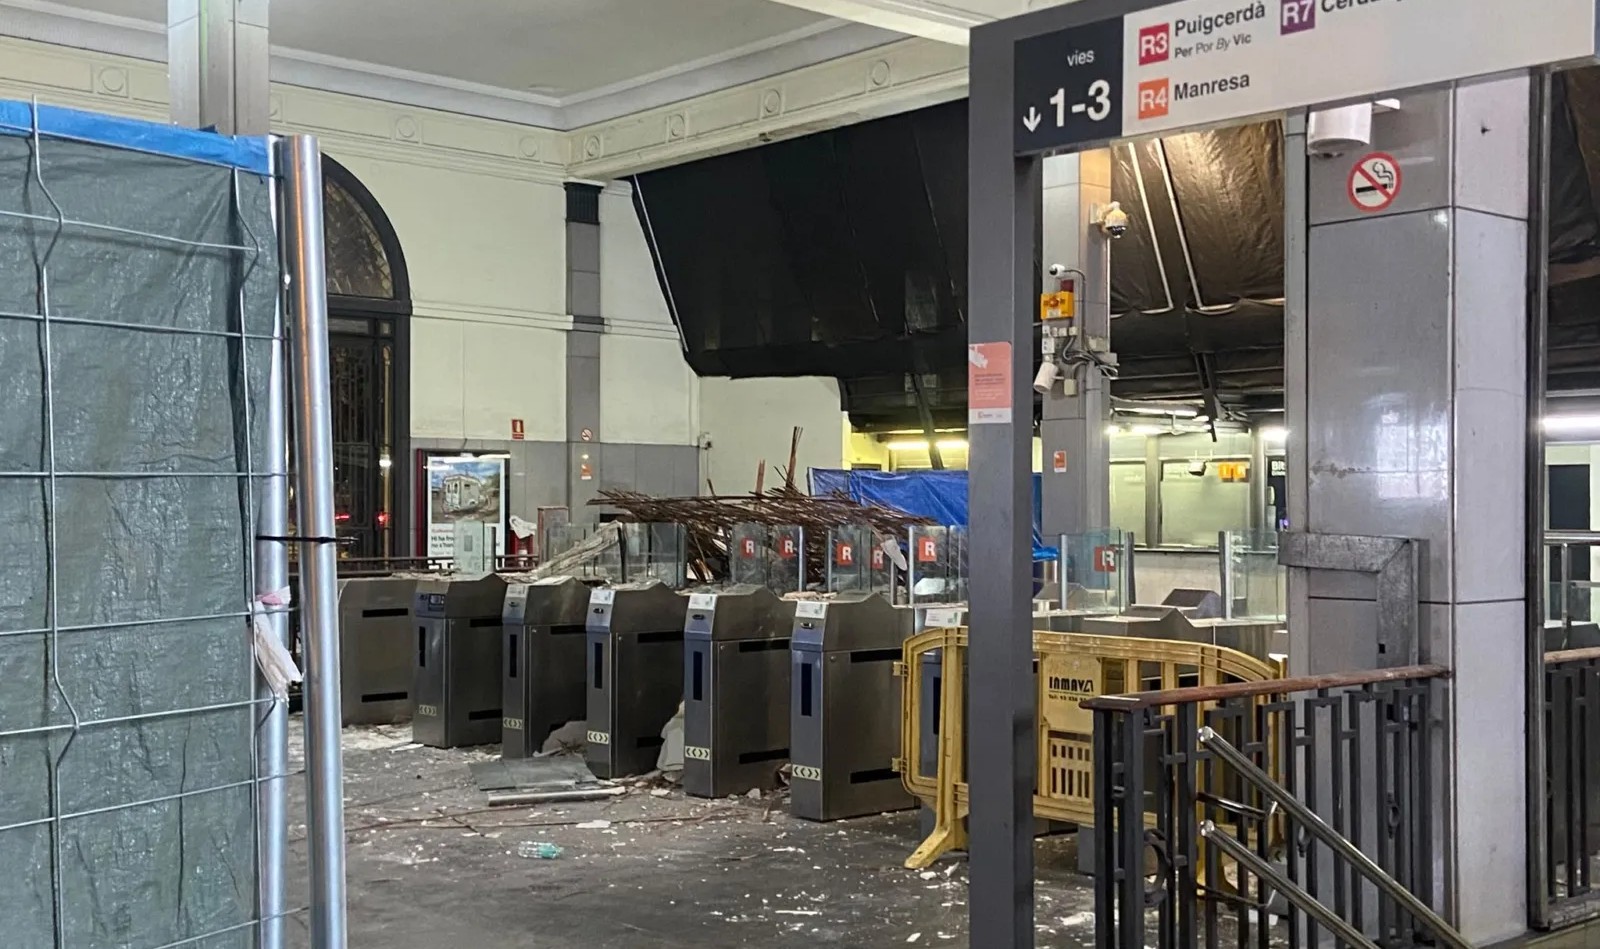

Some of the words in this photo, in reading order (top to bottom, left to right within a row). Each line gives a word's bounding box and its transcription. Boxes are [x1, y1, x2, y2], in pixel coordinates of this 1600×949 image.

[1282, 0, 1313, 26] R7
[1141, 32, 1168, 57] R3
[1174, 1, 1266, 36] Puigcerdà
[1067, 50, 1095, 67] vies
[1175, 47, 1193, 58] Per
[1195, 42, 1213, 54] Por
[1216, 38, 1230, 51] By
[1233, 34, 1251, 46] Vic
[1049, 79, 1111, 127] 1-3
[1140, 86, 1168, 111] R4
[1174, 74, 1250, 101] Manresa
